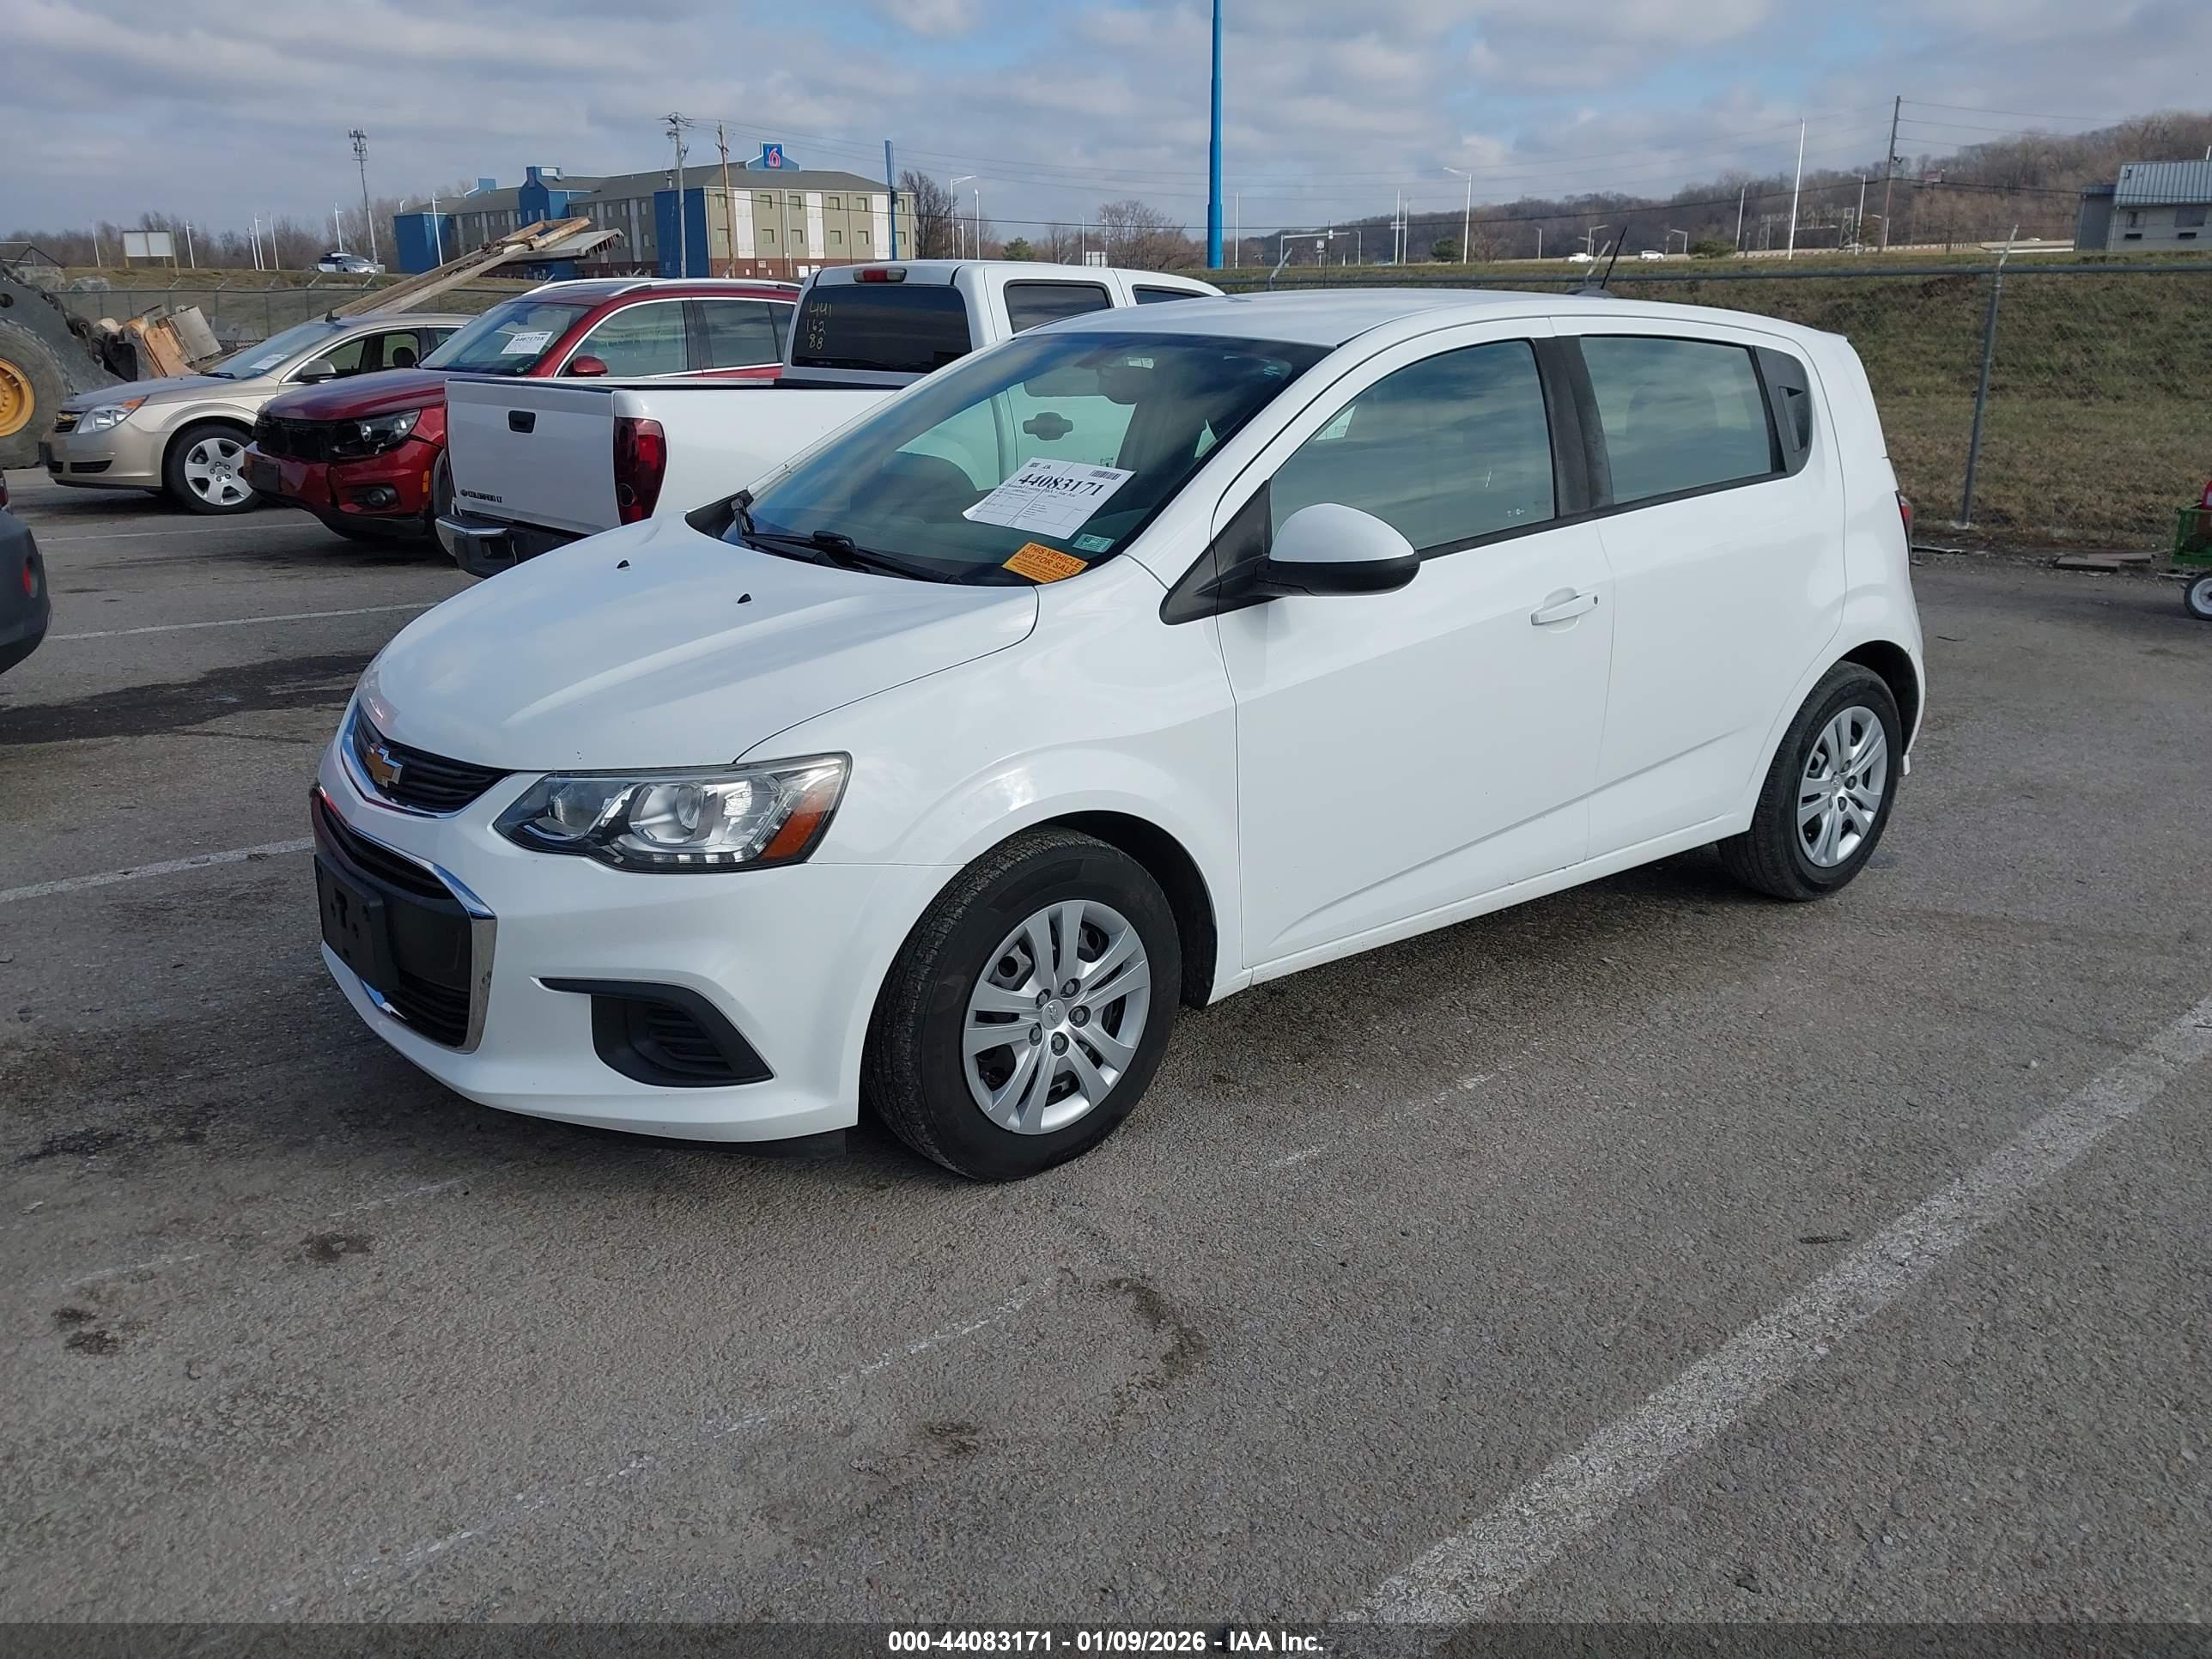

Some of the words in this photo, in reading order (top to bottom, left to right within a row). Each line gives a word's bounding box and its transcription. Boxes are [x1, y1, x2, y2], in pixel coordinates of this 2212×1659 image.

[769, 147, 781, 167] 6
[810, 300, 832, 318] 441
[810, 333, 823, 349] 88
[1018, 473, 1105, 496] 44083171
[1028, 544, 1046, 555] THIS
[1047, 550, 1084, 568] VEHICLE
[1034, 555, 1054, 566] FOR
[1053, 562, 1078, 575] SALE
